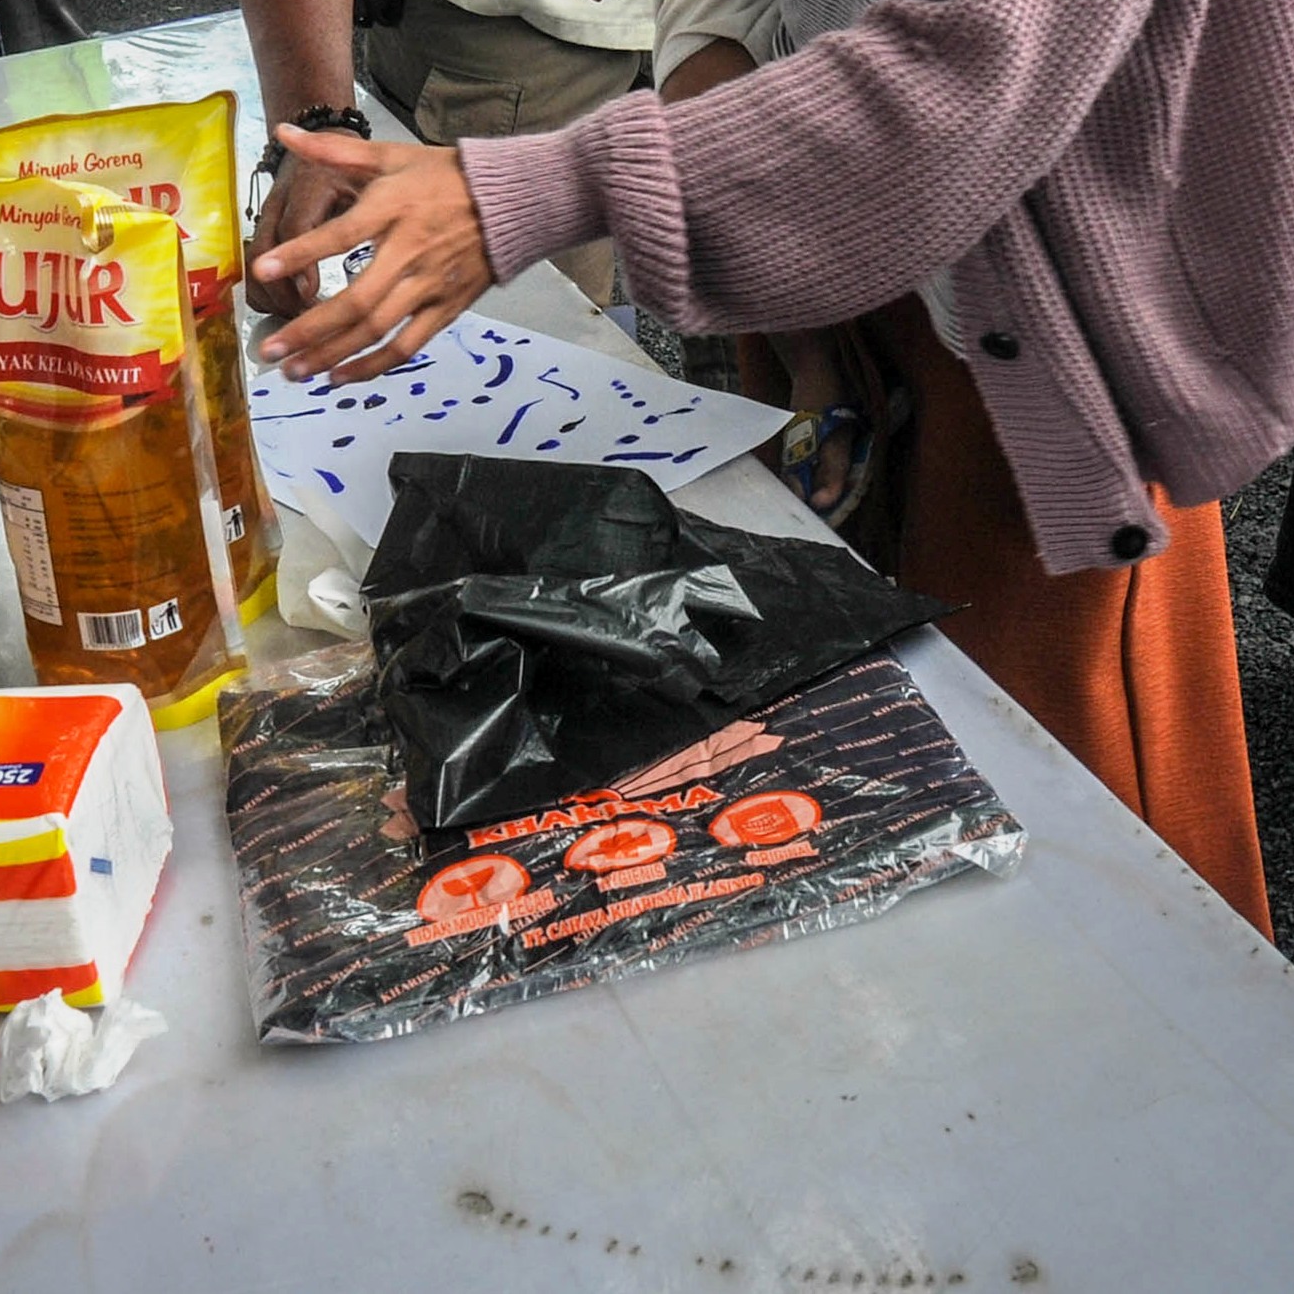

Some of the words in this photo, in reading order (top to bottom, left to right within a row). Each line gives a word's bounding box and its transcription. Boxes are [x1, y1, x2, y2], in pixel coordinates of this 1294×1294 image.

[18, 155, 79, 180] Minyak
[84, 152, 144, 172] Goreng
[85, 366, 143, 385] SAWIT
[835, 732, 896, 752] KHARISMA
[279, 818, 343, 855] KHARISMA
[746, 843, 816, 865] ORIGINAL
[546, 908, 608, 941] CAHAYA
[606, 884, 689, 926] KHARISMA
[688, 872, 766, 905] PLASINDO
[302, 956, 373, 998] KHARISMA
[379, 962, 451, 1005] KHARISMA
